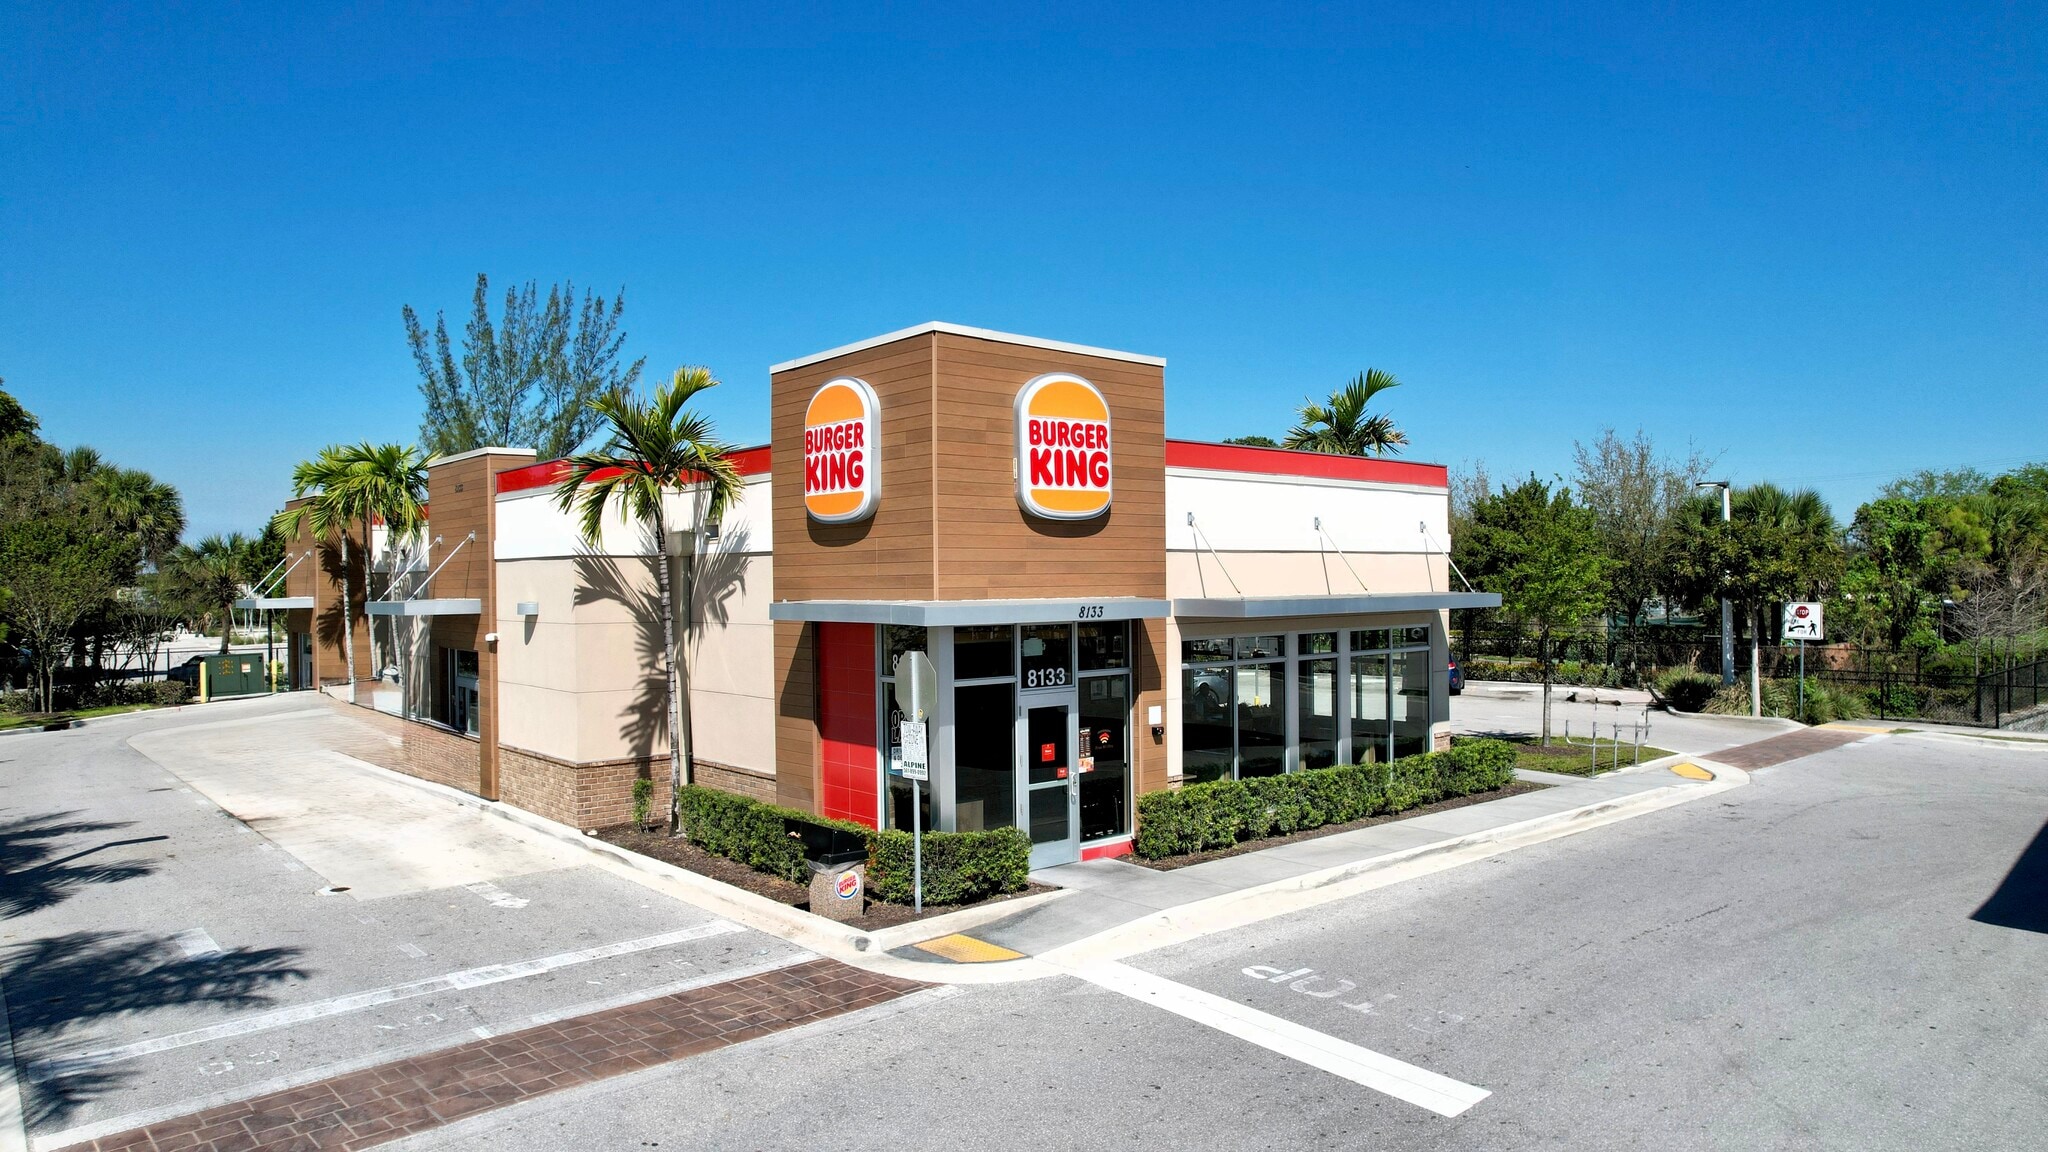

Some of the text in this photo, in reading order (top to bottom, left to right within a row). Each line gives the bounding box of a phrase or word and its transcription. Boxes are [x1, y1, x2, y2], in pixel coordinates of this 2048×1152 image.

[805, 421, 864, 455] BURGER
[1028, 419, 1108, 450] BURGER
[805, 450, 864, 493] KING
[1030, 448, 1110, 488] KING
[1078, 606, 1104, 619] 8133
[1027, 667, 1066, 687] 8133
[903, 760, 926, 770] ALPINE
[839, 880, 857, 893] KING
